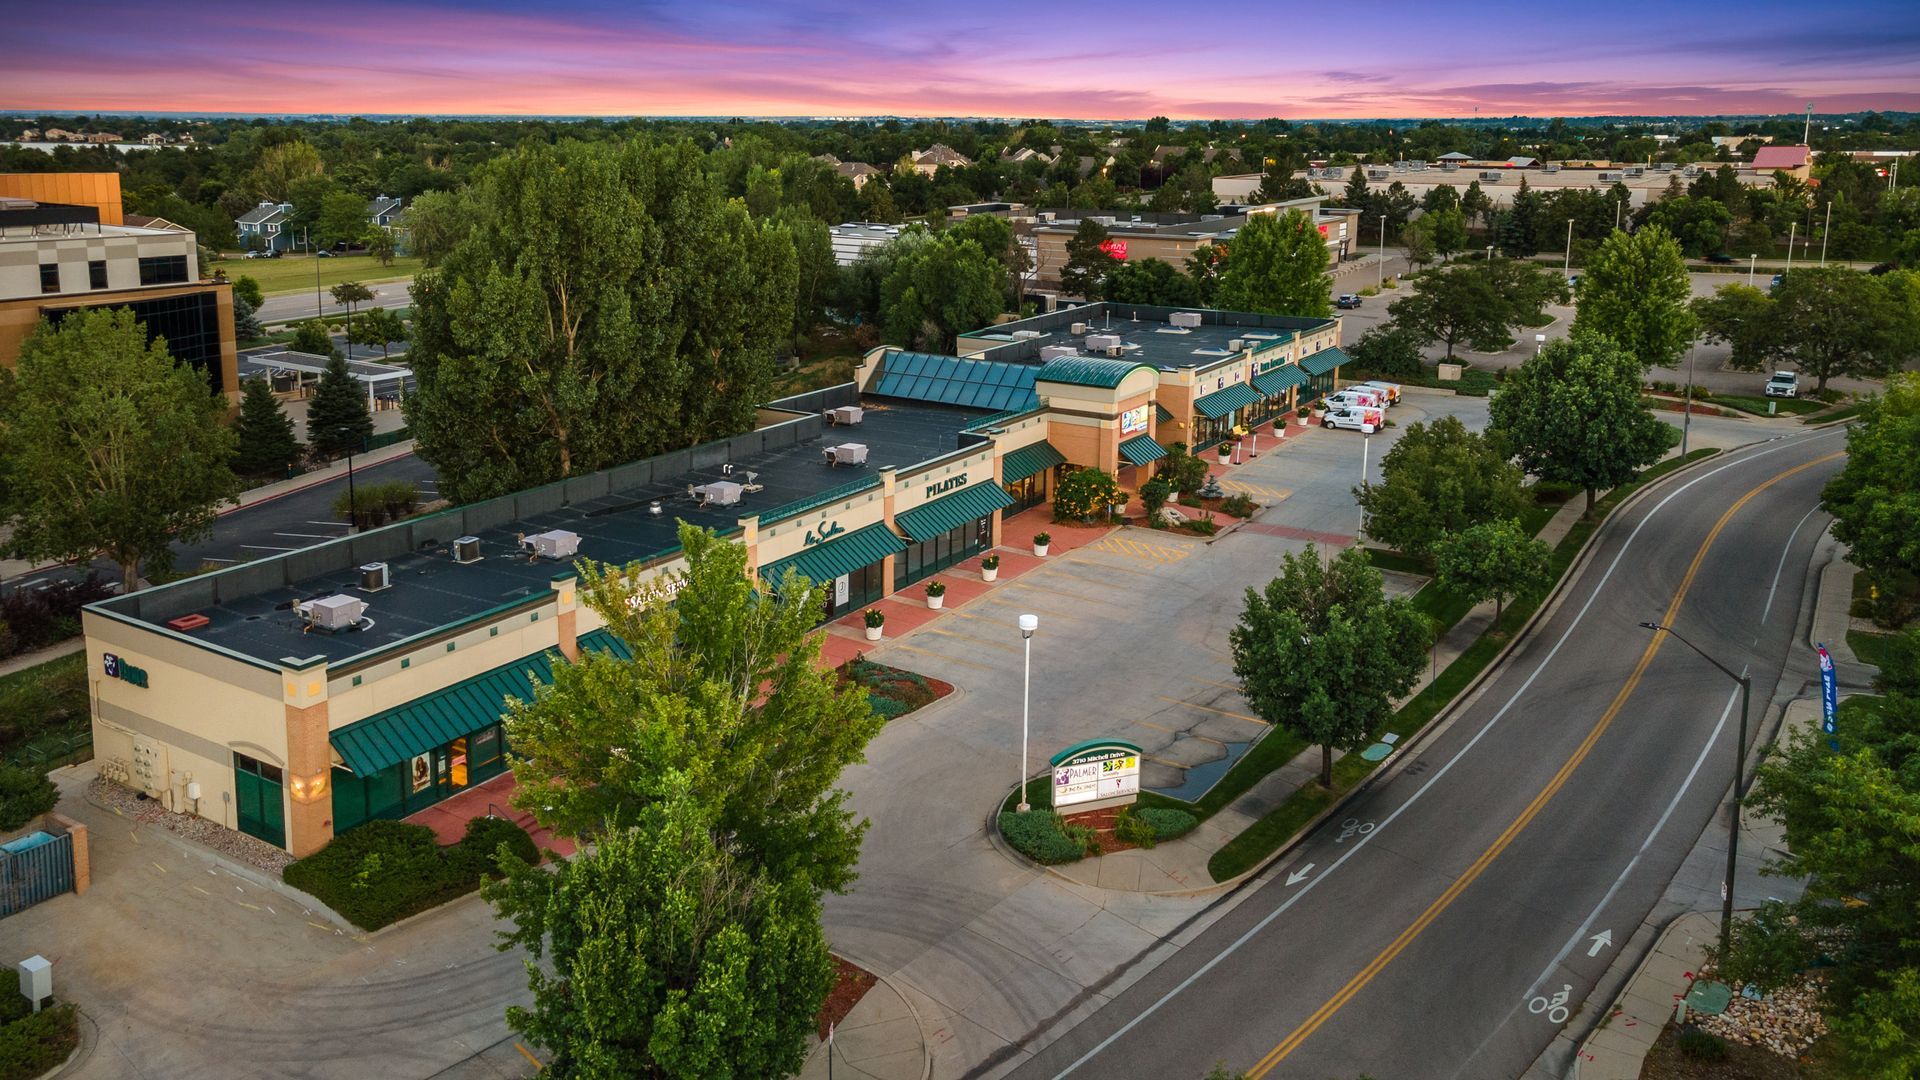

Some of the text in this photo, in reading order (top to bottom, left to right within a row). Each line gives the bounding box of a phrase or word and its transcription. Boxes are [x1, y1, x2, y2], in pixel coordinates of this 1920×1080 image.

[926, 473, 967, 498] PILATES
[1087, 753, 1108, 762] Mitchell
[1110, 751, 1125, 759] Drive
[1069, 767, 1096, 778] PALMER
